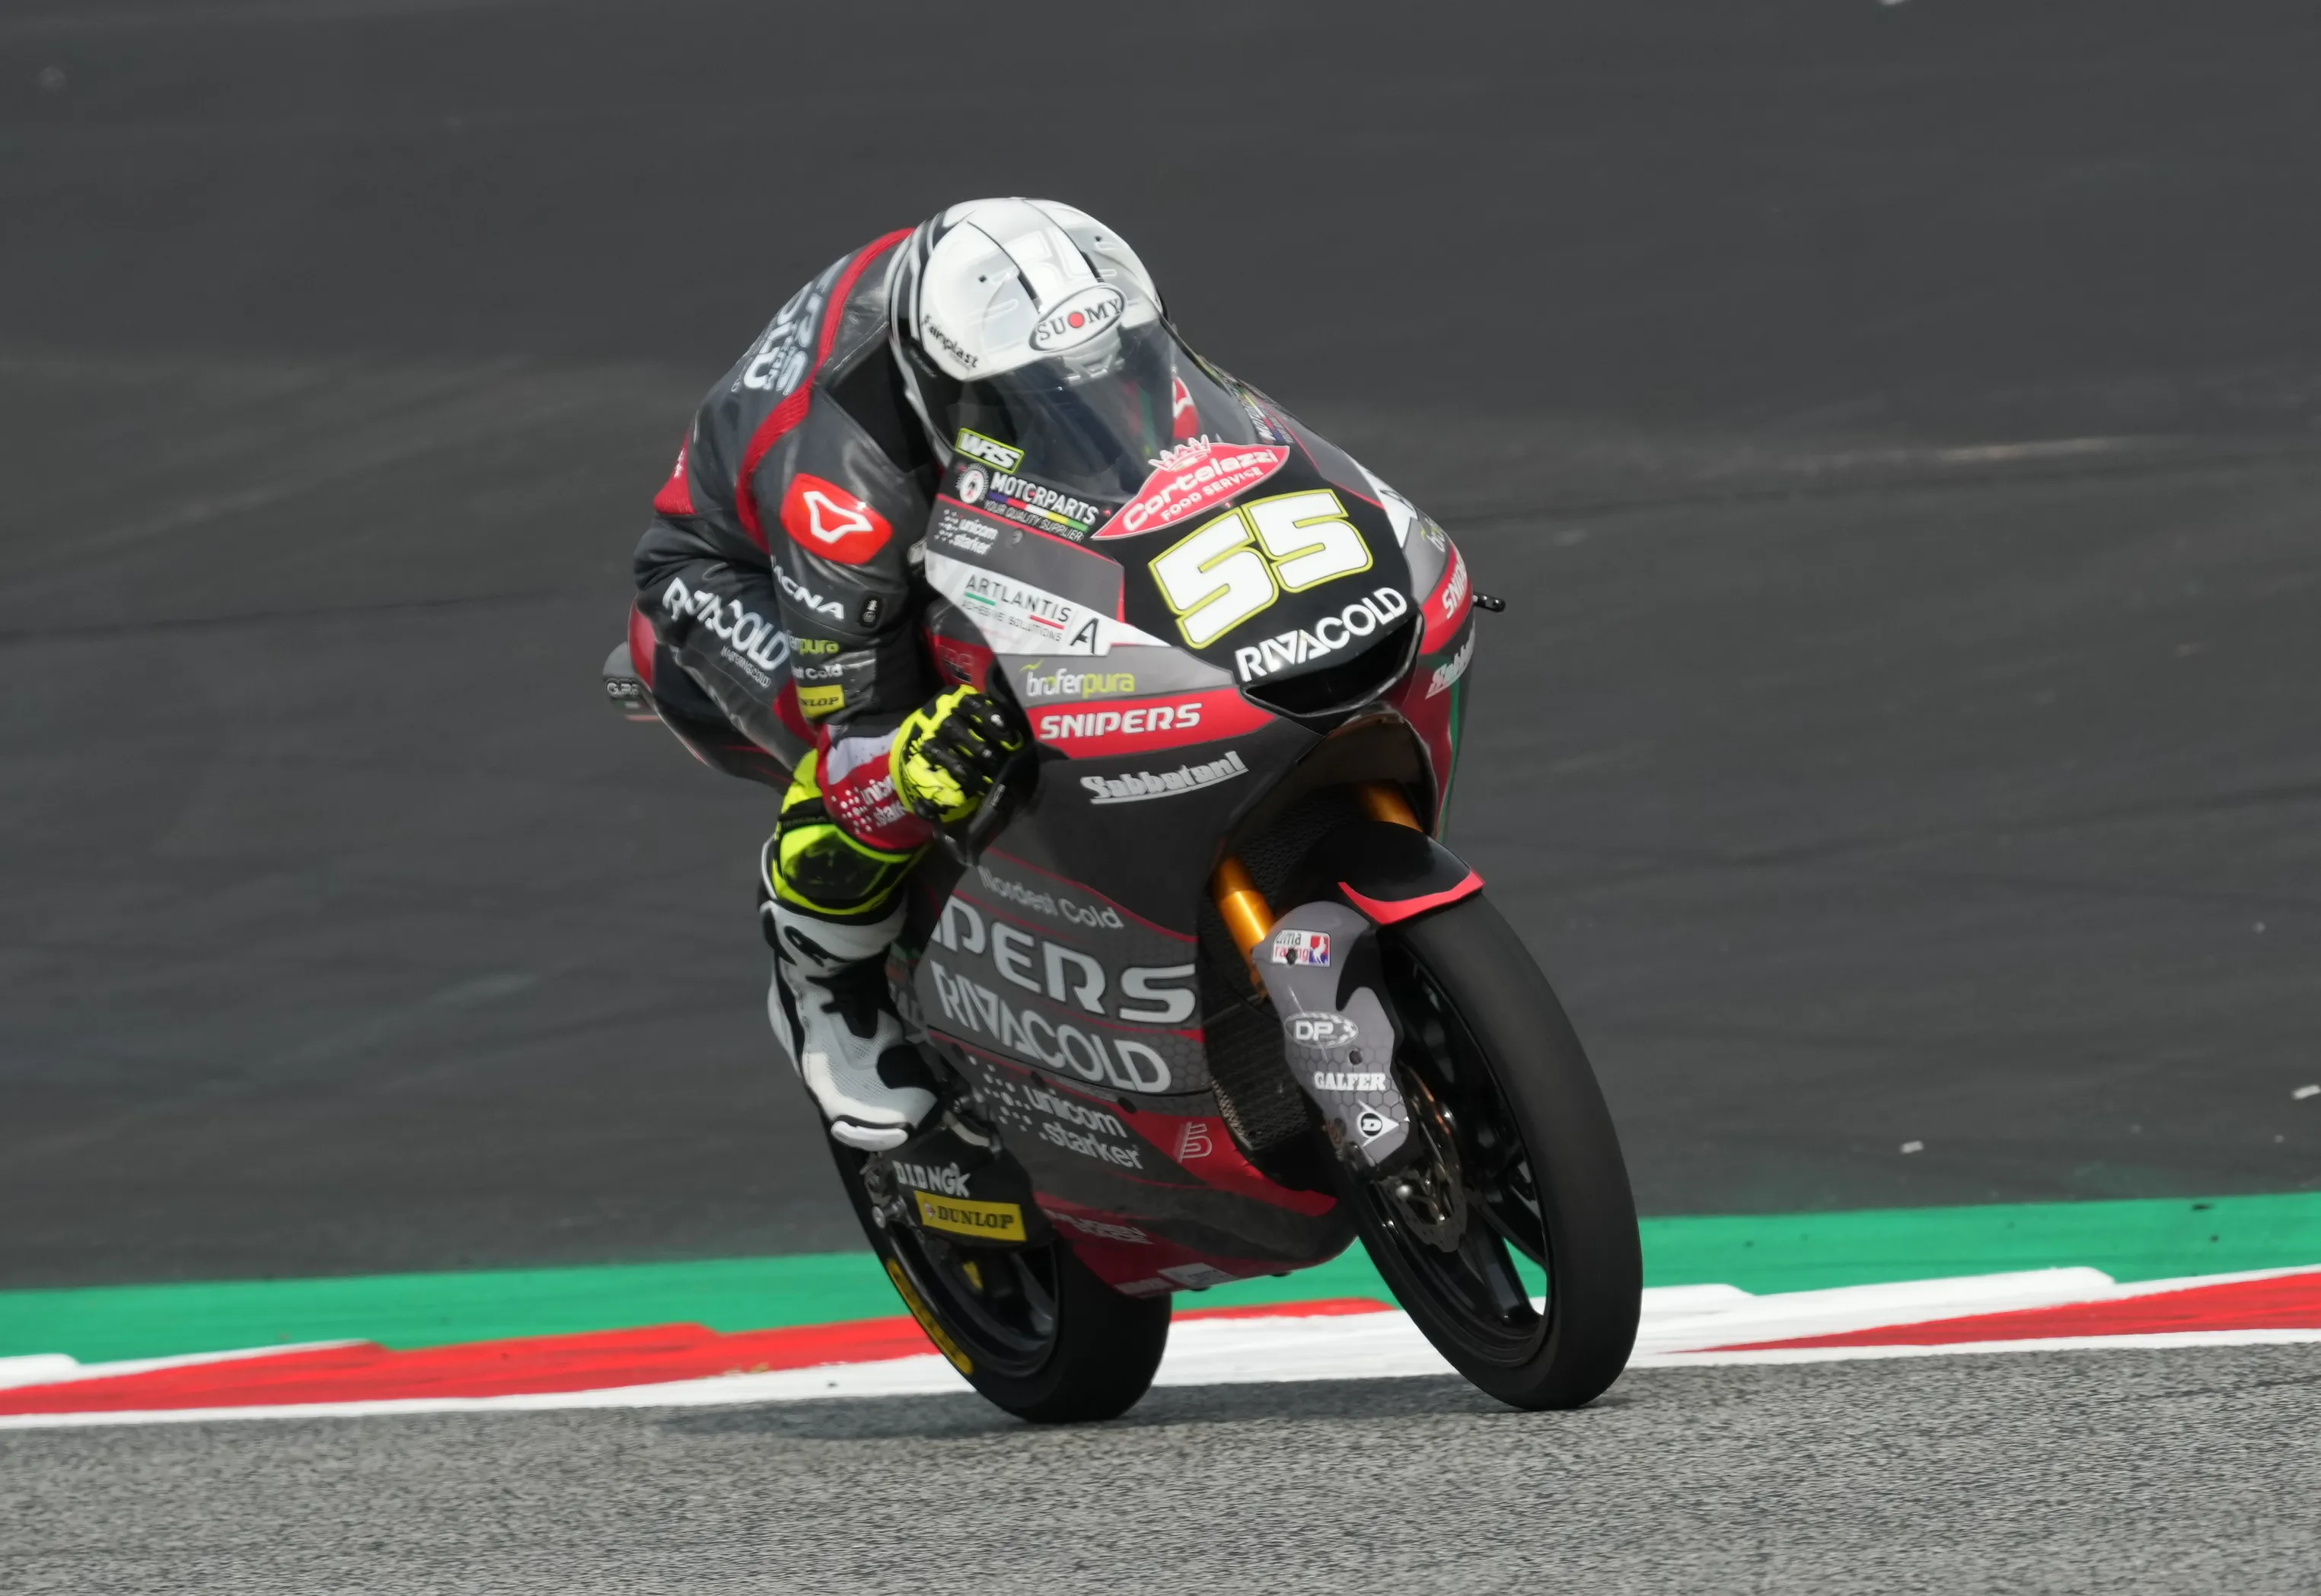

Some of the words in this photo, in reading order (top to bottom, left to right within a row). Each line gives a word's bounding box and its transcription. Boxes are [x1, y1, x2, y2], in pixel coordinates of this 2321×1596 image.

[961, 432, 1019, 469] WRS
[990, 471, 1099, 526] MOTORPARTS
[1123, 449, 1279, 532] Cortelazzi
[1159, 489, 1202, 522] FOOD
[1203, 466, 1265, 499] SERVICE
[1006, 507, 1043, 527] QUALITY
[1039, 520, 1085, 543] SUPPLIER
[1148, 489, 1373, 650] 55
[965, 573, 1073, 623] ARTLANTIS
[1234, 587, 1408, 683] RIVACOLD
[1039, 702, 1203, 741] SNIPERS
[1079, 750, 1247, 801] Sabbatani
[977, 865, 1060, 916] Nordest
[1063, 897, 1125, 929] Cold
[930, 960, 1172, 1093] RIVACOLD
[1314, 1072, 1386, 1091] GALFER
[1022, 1083, 1128, 1139] unicom
[1046, 1121, 1143, 1170] starker
[926, 1161, 972, 1199] NGK
[937, 1206, 1015, 1230] DUNLOP
